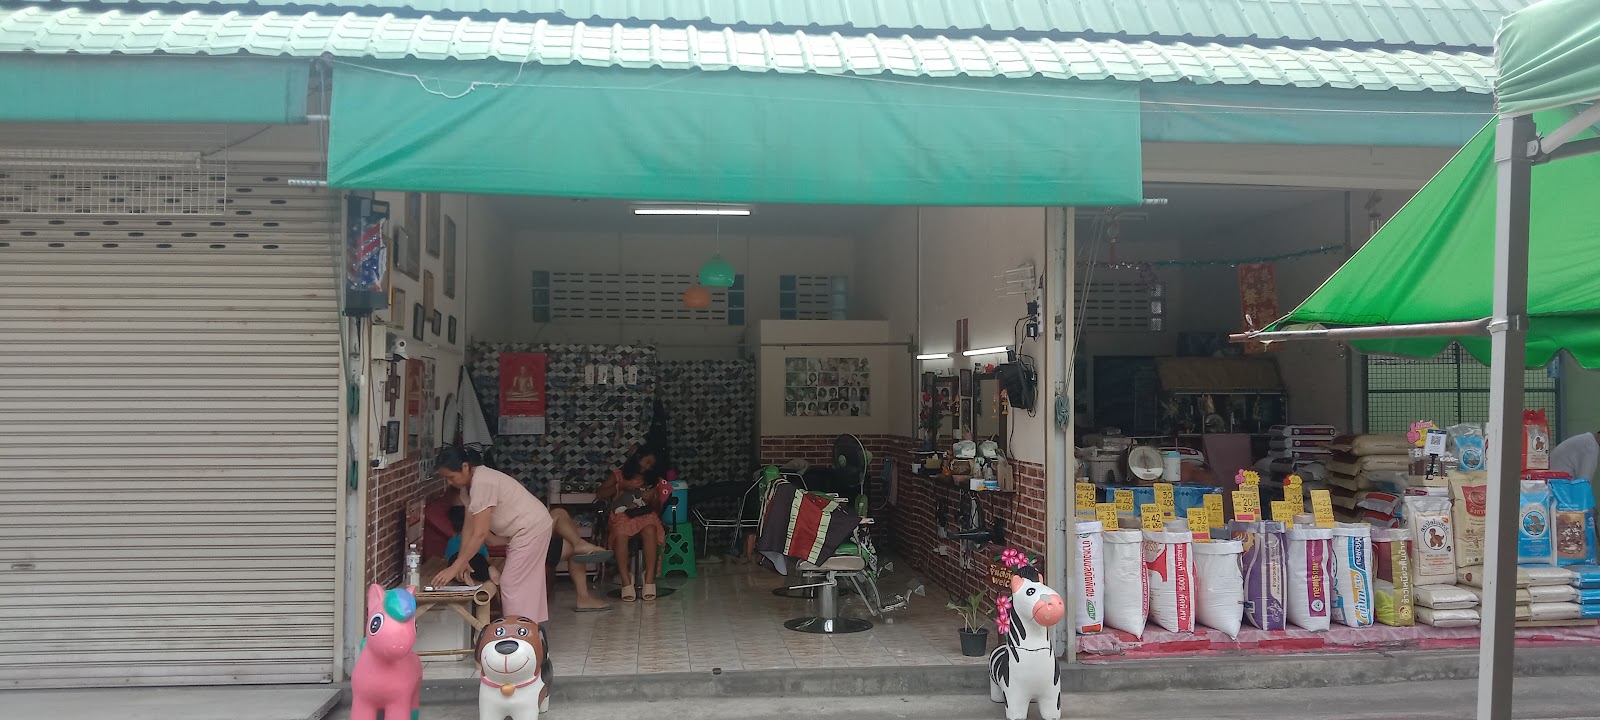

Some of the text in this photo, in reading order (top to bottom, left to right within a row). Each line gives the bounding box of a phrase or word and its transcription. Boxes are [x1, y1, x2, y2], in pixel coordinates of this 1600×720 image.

[1084, 492, 1095, 501] 45
[1162, 491, 1173, 500] 30
[1123, 497, 1134, 505] 40
[1243, 498, 1253, 507] 20
[1105, 511, 1116, 521] 33
[1151, 513, 1161, 523] 42
[1196, 515, 1207, 525] 32
[1177, 574, 1186, 592] 100%
